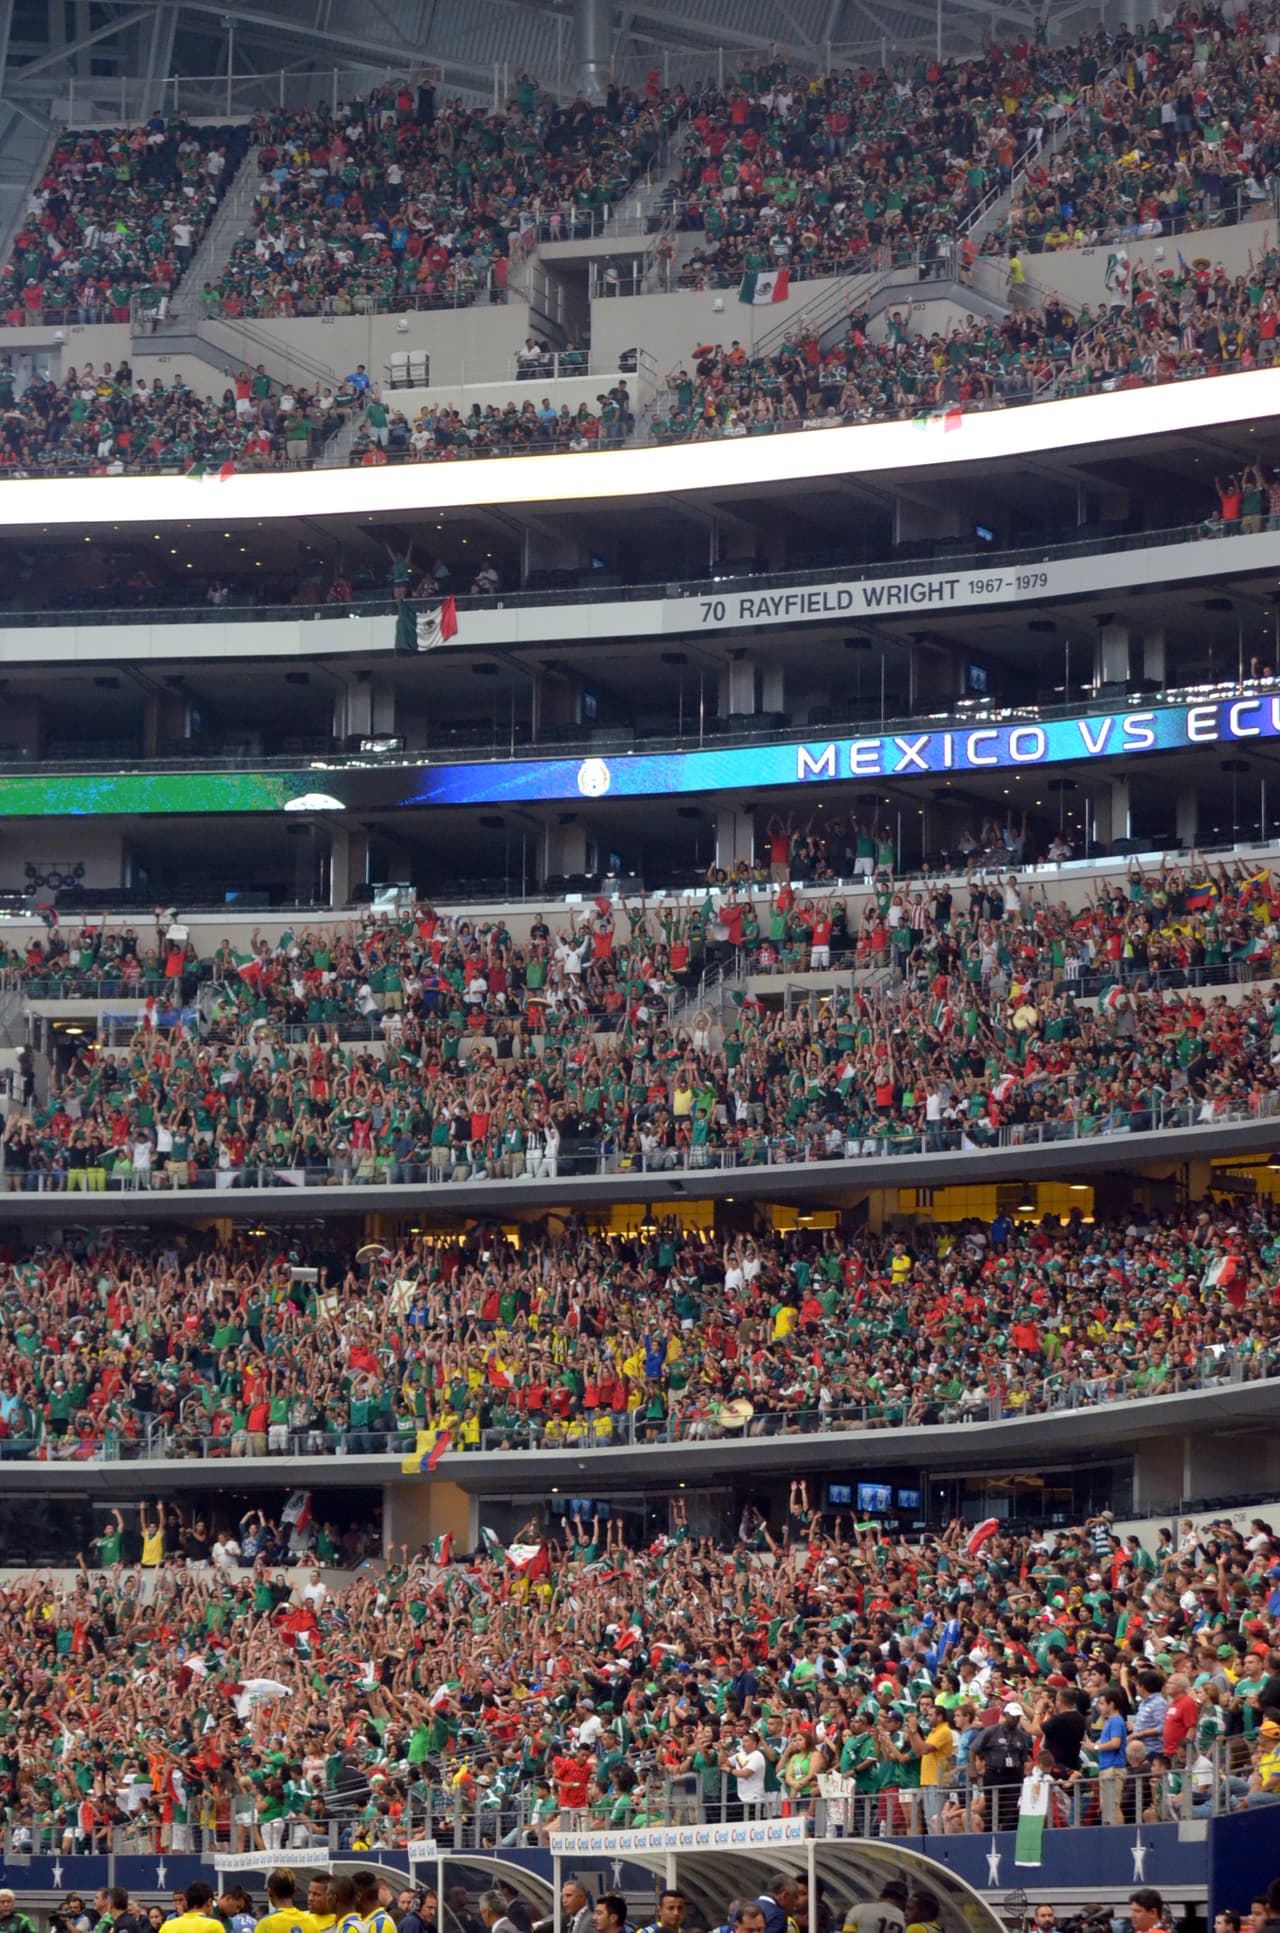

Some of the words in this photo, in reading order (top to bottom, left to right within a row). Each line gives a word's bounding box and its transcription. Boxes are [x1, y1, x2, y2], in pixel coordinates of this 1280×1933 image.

[700, 601, 726, 623] 70
[739, 590, 853, 619] RAYFIELD
[862, 579, 960, 607] WRIGHT
[796, 728, 1045, 779] MEXICO
[1078, 713, 1157, 754] VS
